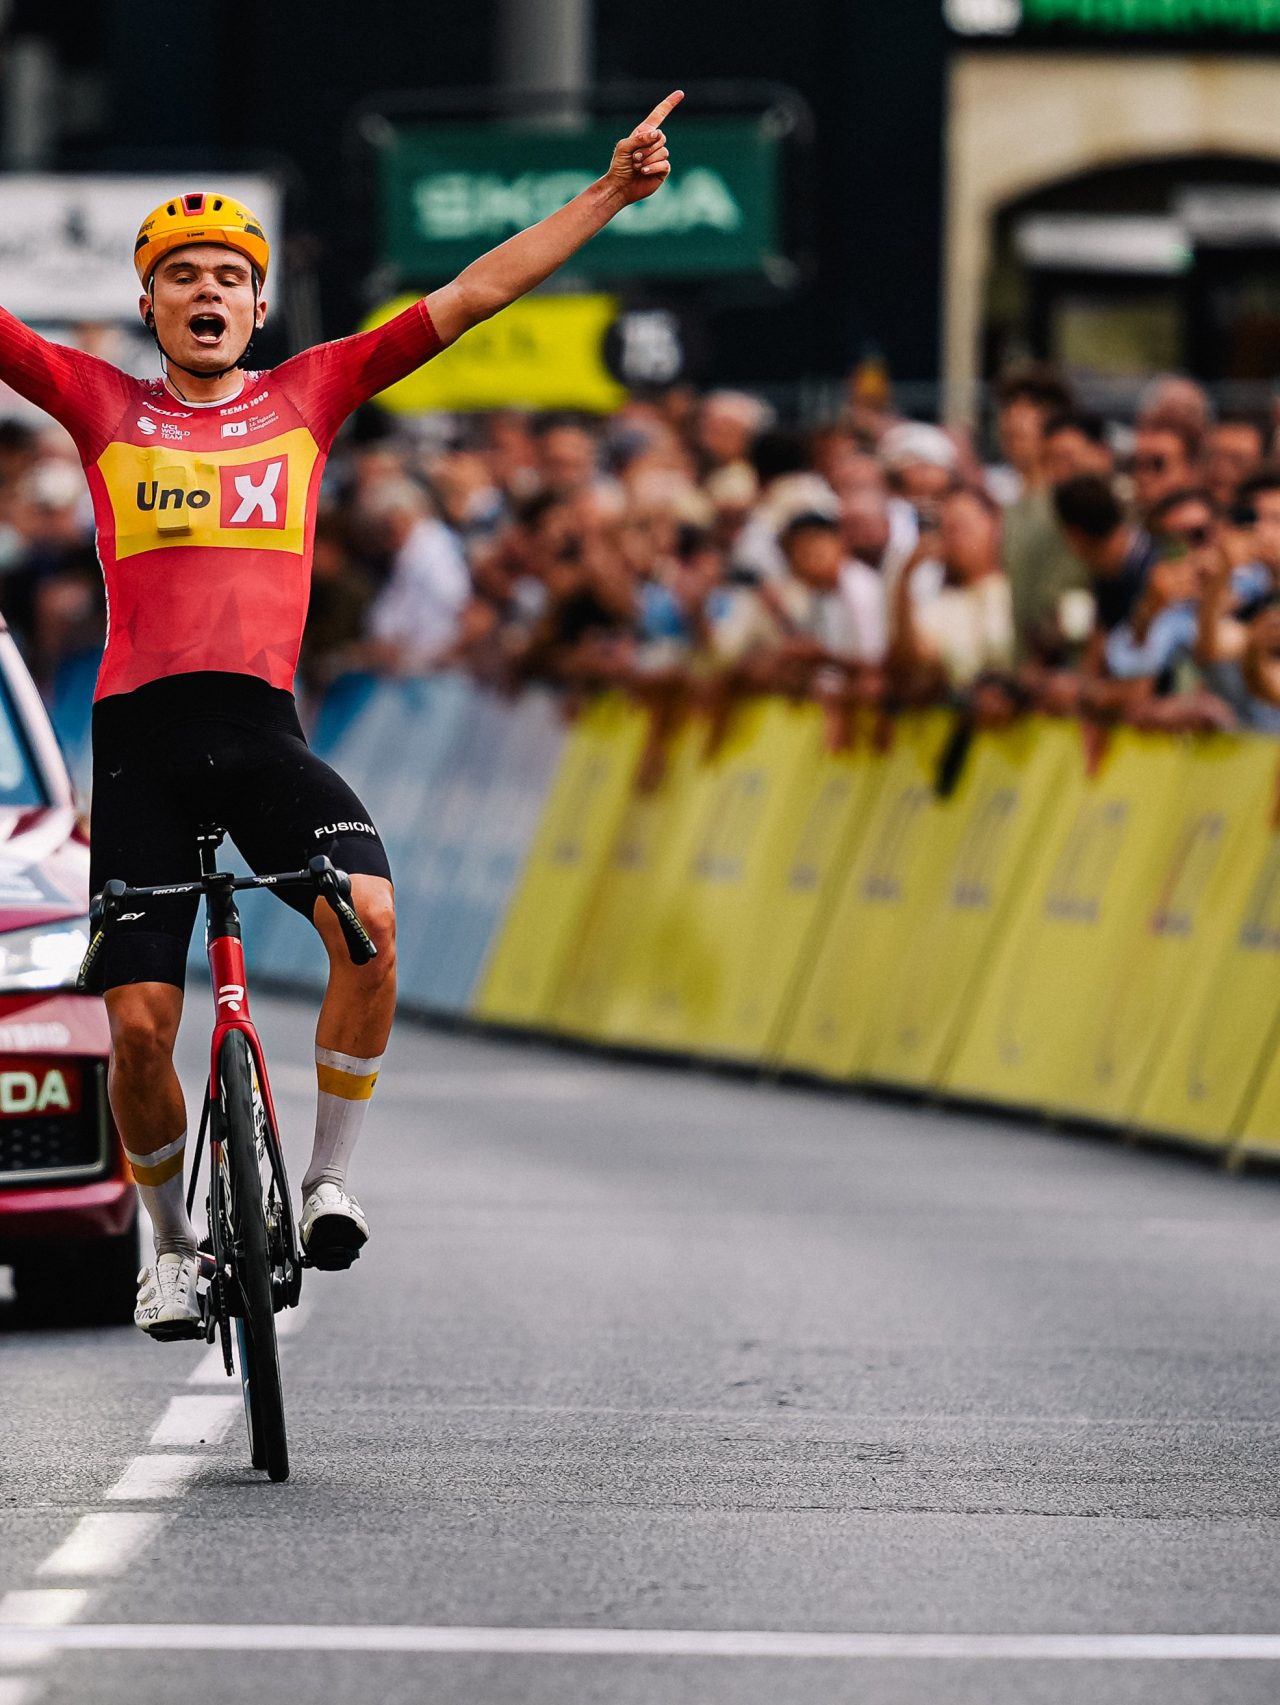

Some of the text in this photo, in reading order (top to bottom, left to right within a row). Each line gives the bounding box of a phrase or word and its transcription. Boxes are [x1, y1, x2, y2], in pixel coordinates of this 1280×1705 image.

[142, 401, 193, 418] RIDLEY
[220, 391, 269, 416] REMA 1000
[161, 428, 191, 436] WORLD
[161, 433, 183, 441] TEAM
[230, 425, 239, 434] U
[136, 461, 282, 523] Uno X
[314, 821, 376, 839] FUSION
[152, 886, 193, 896] RIDLEY
[337, 900, 370, 943] SRAM
[80, 930, 105, 976] SRAM
